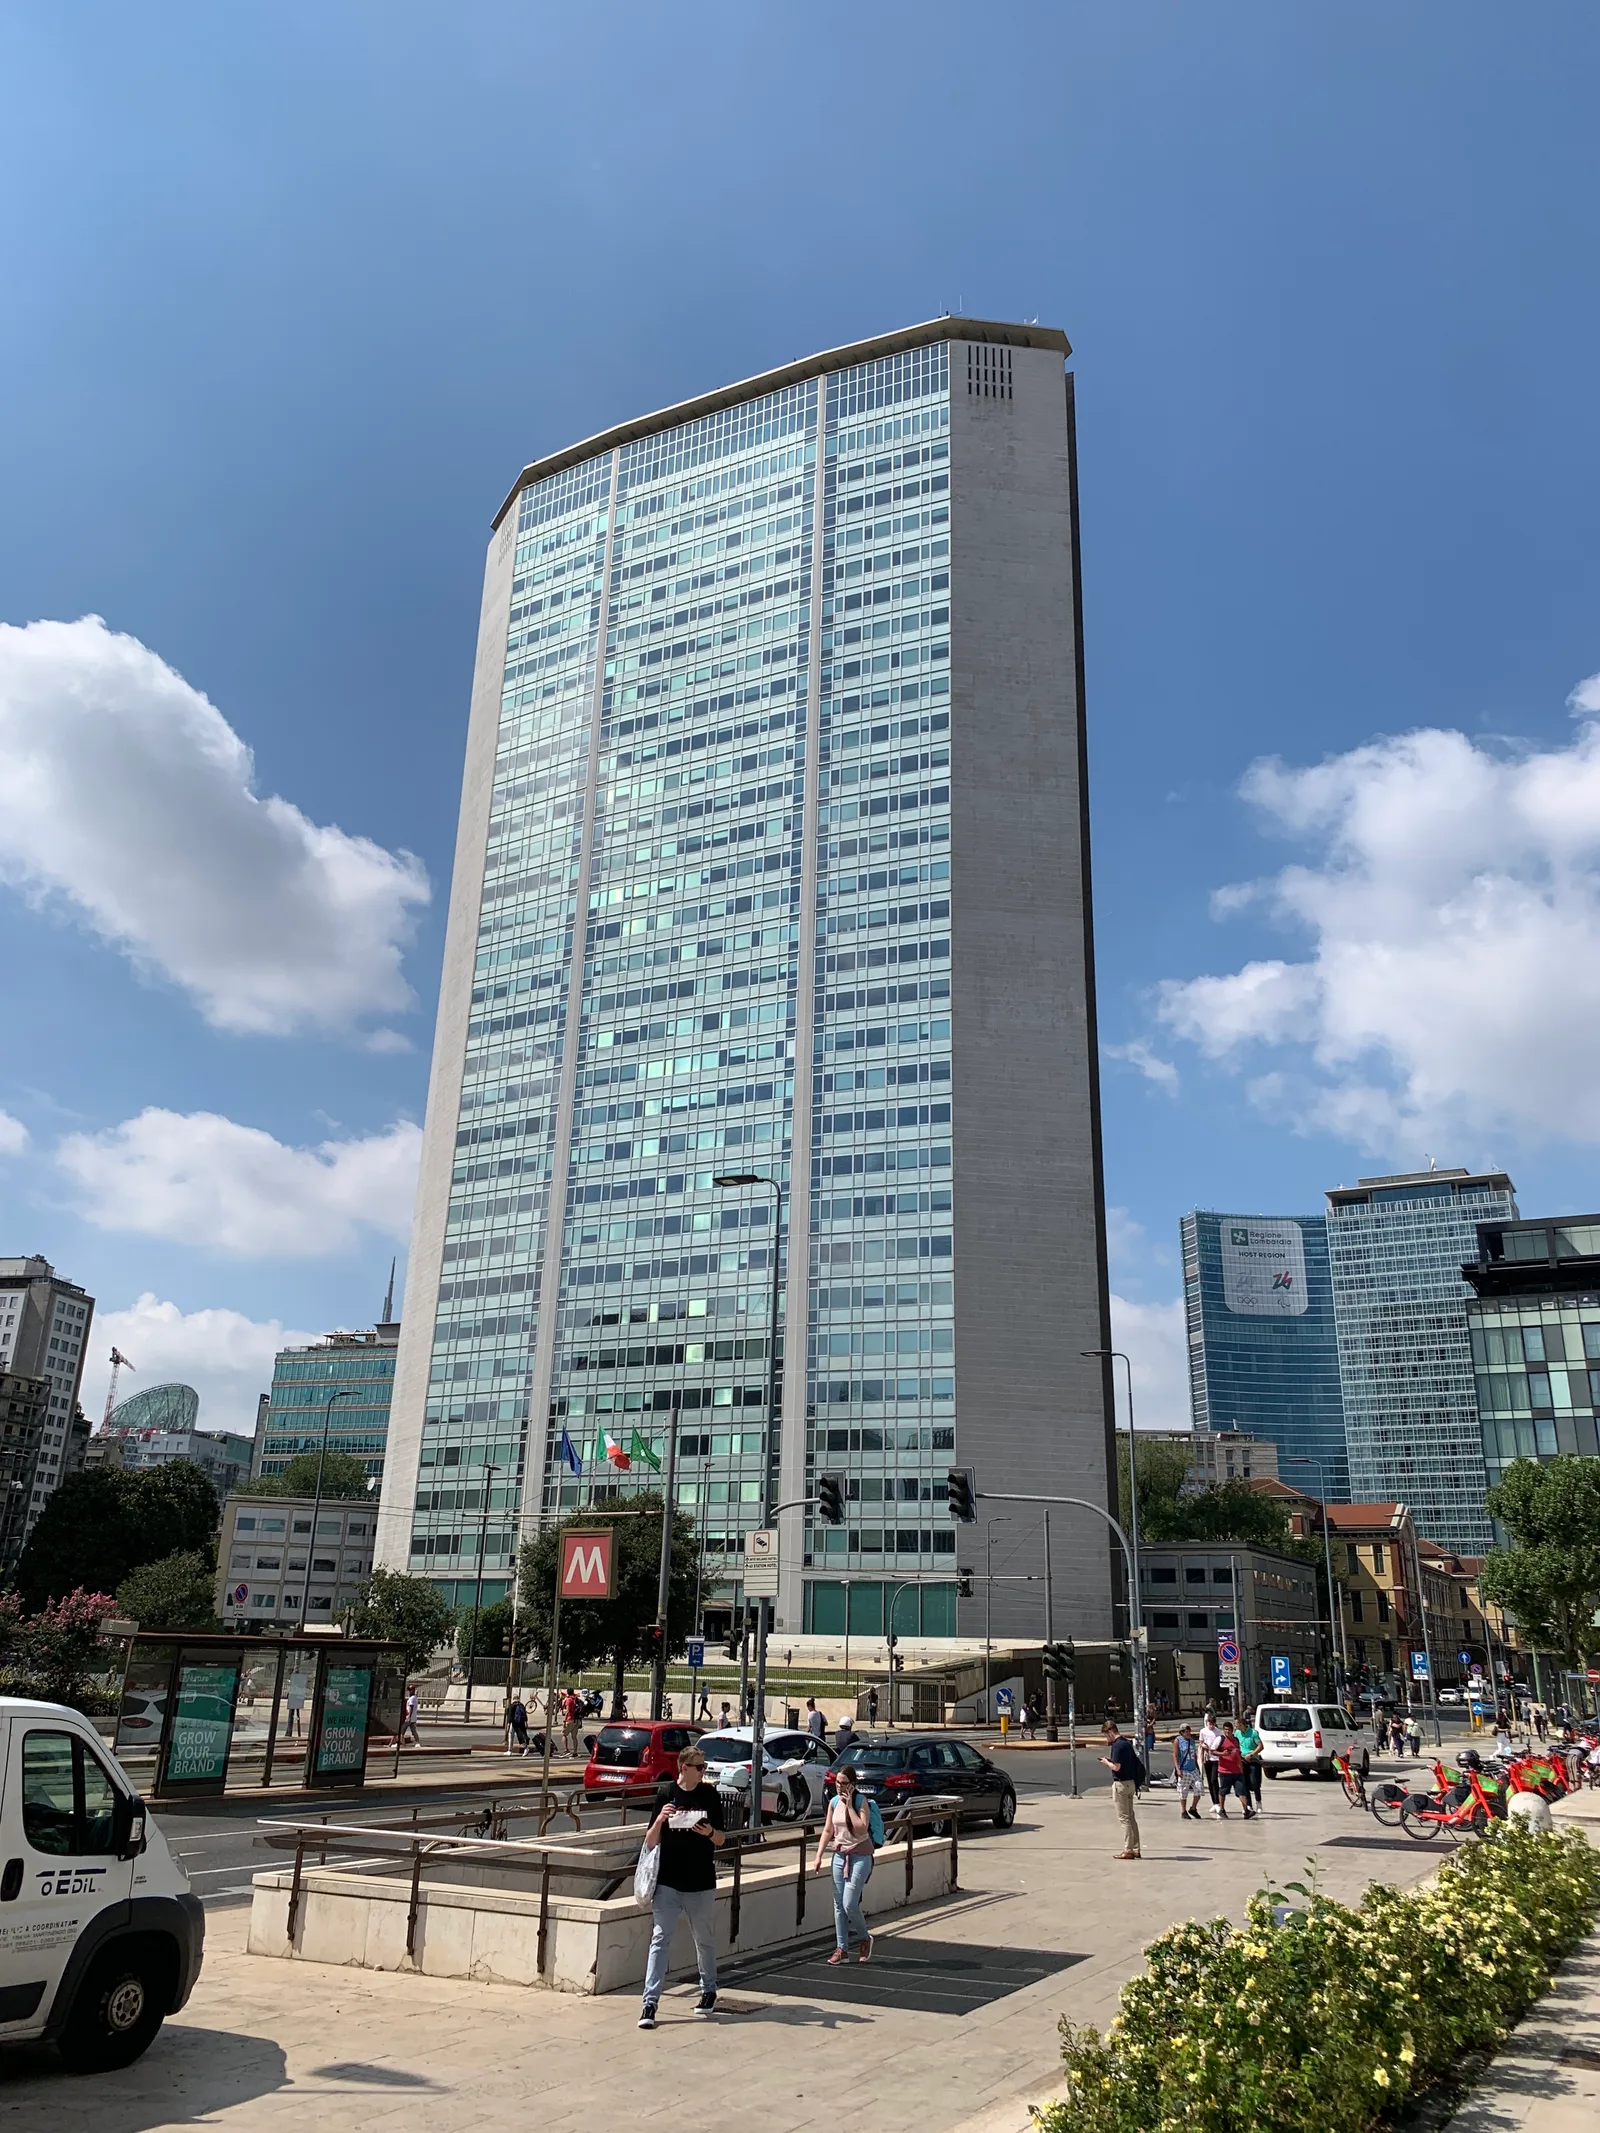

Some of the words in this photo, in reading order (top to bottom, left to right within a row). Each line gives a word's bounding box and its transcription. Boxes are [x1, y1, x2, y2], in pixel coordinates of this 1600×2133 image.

[1249, 1231, 1282, 1239] Regione
[564, 1546, 606, 1584] M
[692, 1644, 701, 1656] P
[1274, 1658, 1285, 1674] P
[1414, 1653, 1424, 1665] P
[338, 1715, 354, 1724] HELP
[178, 1731, 217, 1745] GROW
[325, 1726, 357, 1740] GROW
[176, 1745, 210, 1760] YOUR
[323, 1739, 351, 1753] YOUR
[173, 1759, 215, 1774] BRAND
[321, 1752, 356, 1767] BRAND
[32, 1920, 72, 1932] COORDINATA
